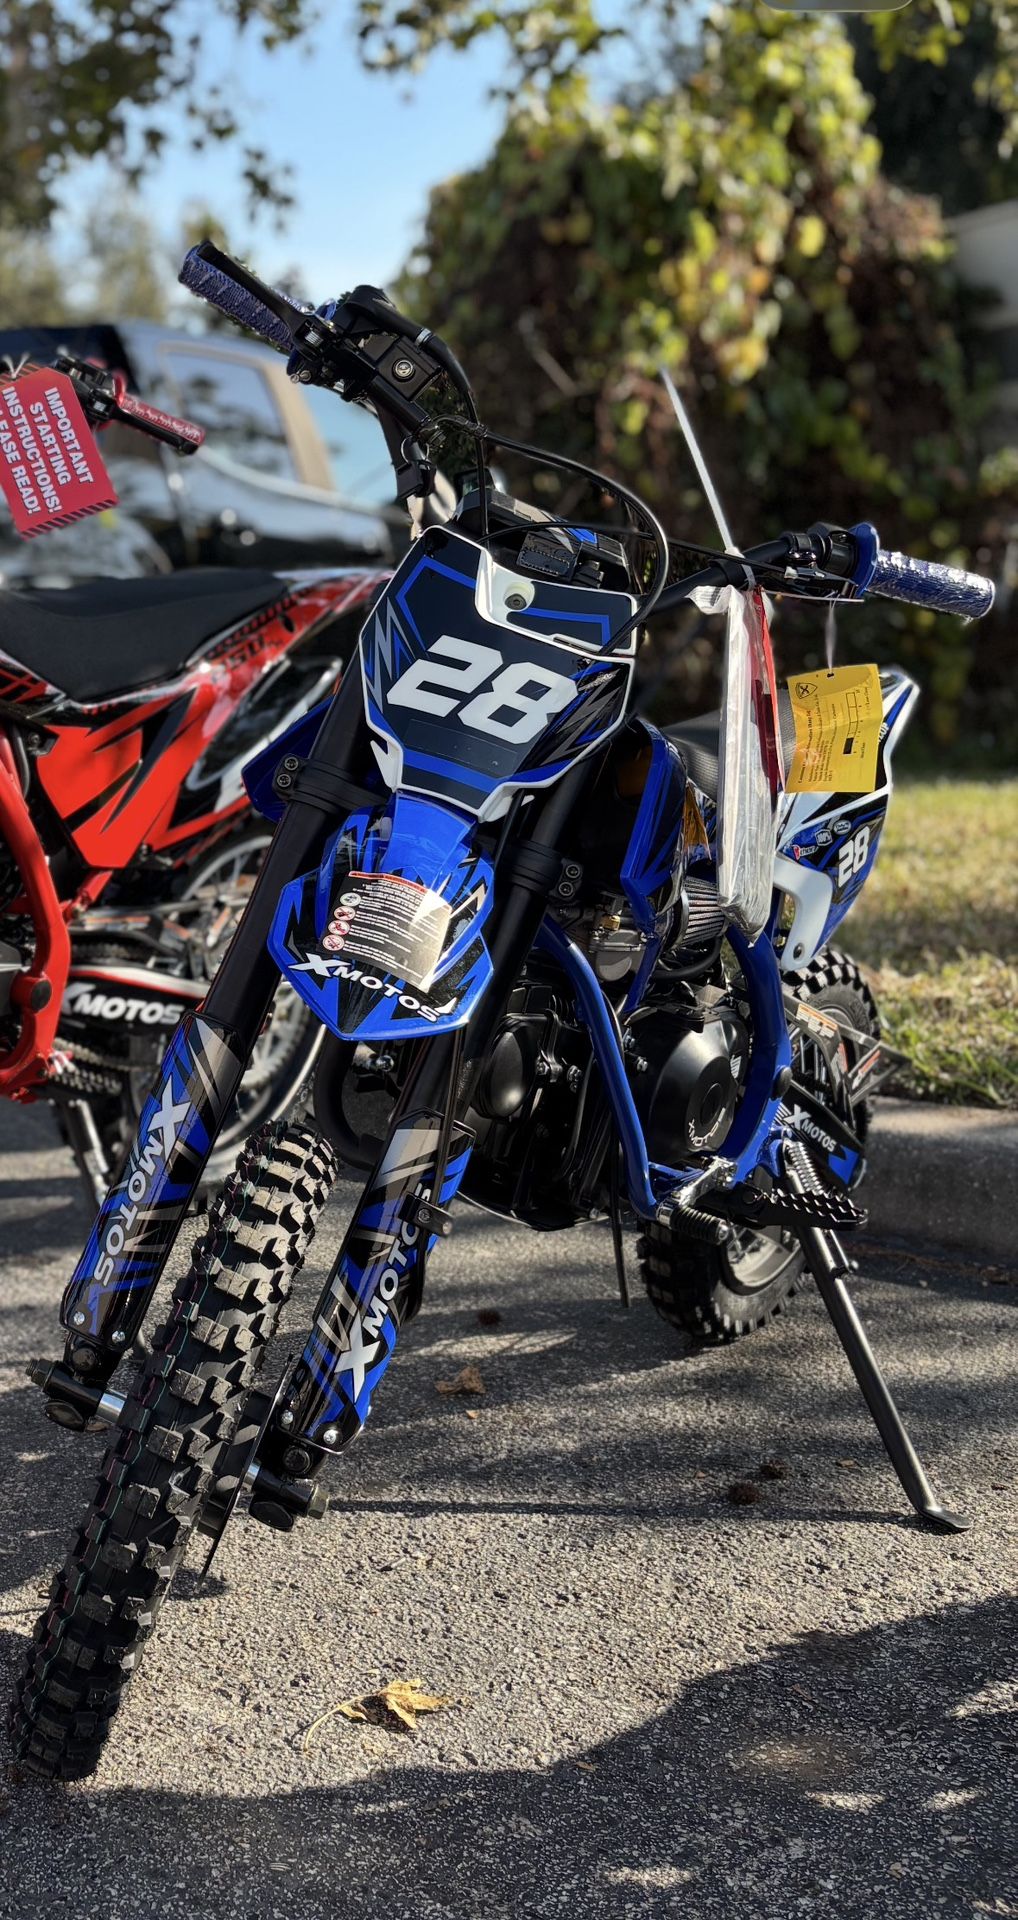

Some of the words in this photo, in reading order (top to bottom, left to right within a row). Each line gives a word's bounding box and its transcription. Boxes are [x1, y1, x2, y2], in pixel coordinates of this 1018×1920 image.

[0, 409, 21, 464] EASE
[11, 465, 41, 515] READ!
[2, 386, 63, 514] INSTRUCTIONS!
[29, 401, 72, 486] STARTING
[44, 387, 94, 484] IMPORTANT
[386, 634, 579, 744] 28
[837, 825, 870, 888] 28
[287, 952, 442, 1023] XMOTOS
[783, 1103, 838, 1152] XMOTOS
[93, 1074, 191, 1287] XMOTOS
